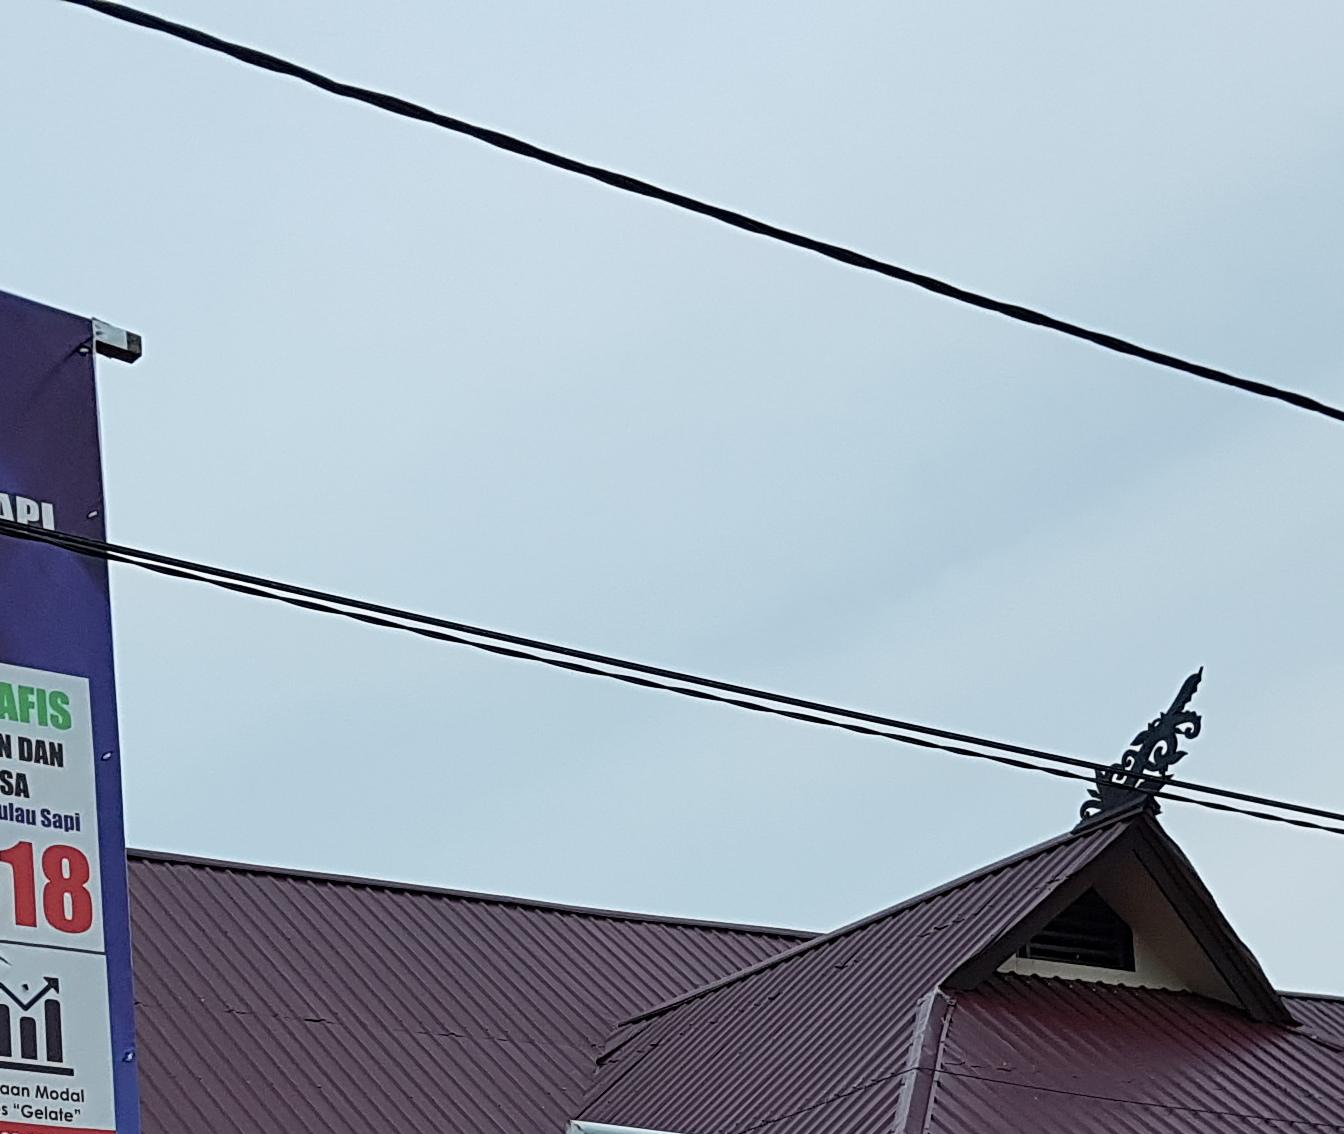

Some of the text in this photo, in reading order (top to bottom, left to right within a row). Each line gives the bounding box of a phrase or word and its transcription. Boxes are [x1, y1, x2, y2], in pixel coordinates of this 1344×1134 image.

[17, 735, 64, 768] DAN
[39, 807, 81, 833] Sapi
[34, 1084, 85, 1103] Modal
